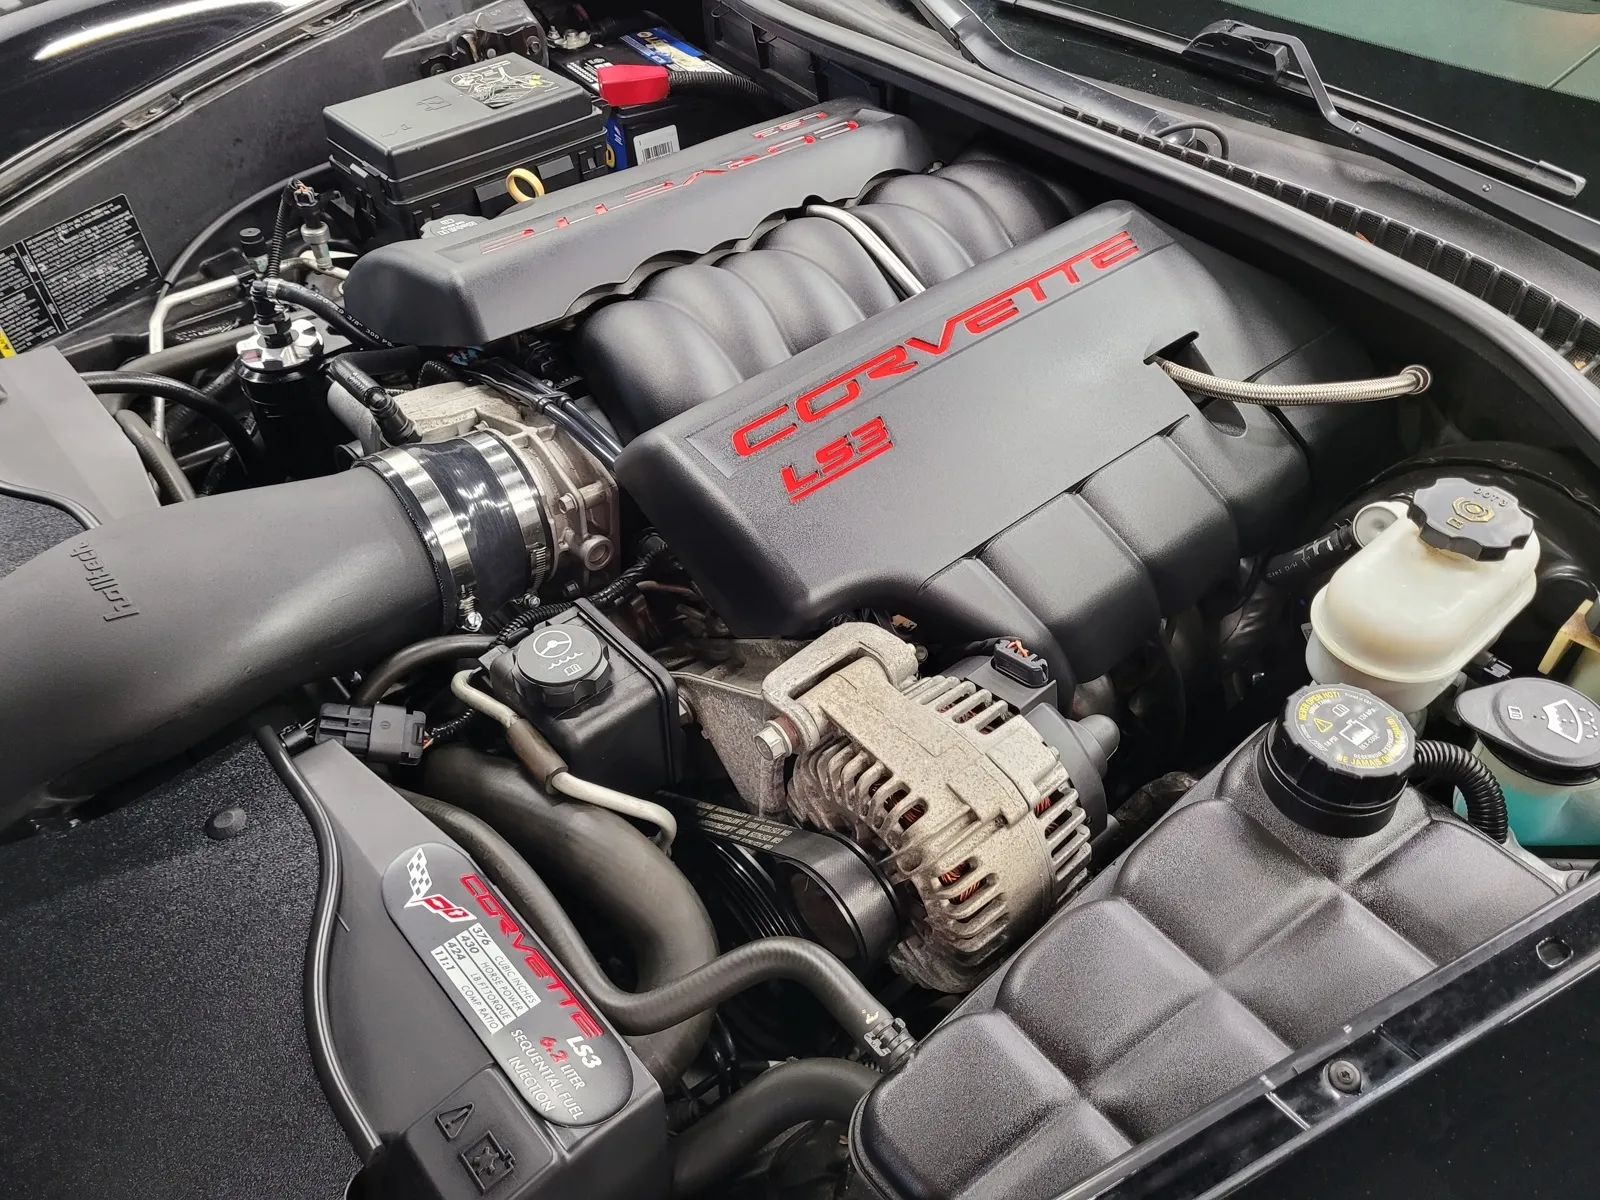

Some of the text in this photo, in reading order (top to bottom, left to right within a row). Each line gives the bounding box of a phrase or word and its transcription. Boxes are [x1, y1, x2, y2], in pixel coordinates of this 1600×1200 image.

[731, 230, 1139, 458] CORVETTE
[781, 415, 892, 495] LS3
[1473, 488, 1499, 502] DOT
[1305, 693, 1323, 706] OPEN
[1321, 691, 1341, 699] HOT!
[1350, 758, 1383, 767] JAMAIS
[435, 950, 456, 970] 11:1
[478, 1007, 499, 1029] RATIO
[447, 942, 466, 960] 424
[486, 989, 512, 1020] TORQUE
[459, 872, 605, 1038] CORVETTE
[461, 935, 523, 1011] 430 HORSE POWER
[472, 926, 537, 1004] 376 CUBIC INCHES
[508, 1056, 556, 1112] INJECTION
[510, 1029, 585, 1120] SEQUENTIAL FUEL
[539, 1036, 586, 1091] 6.2 LITER
[566, 1035, 603, 1068] LS3
